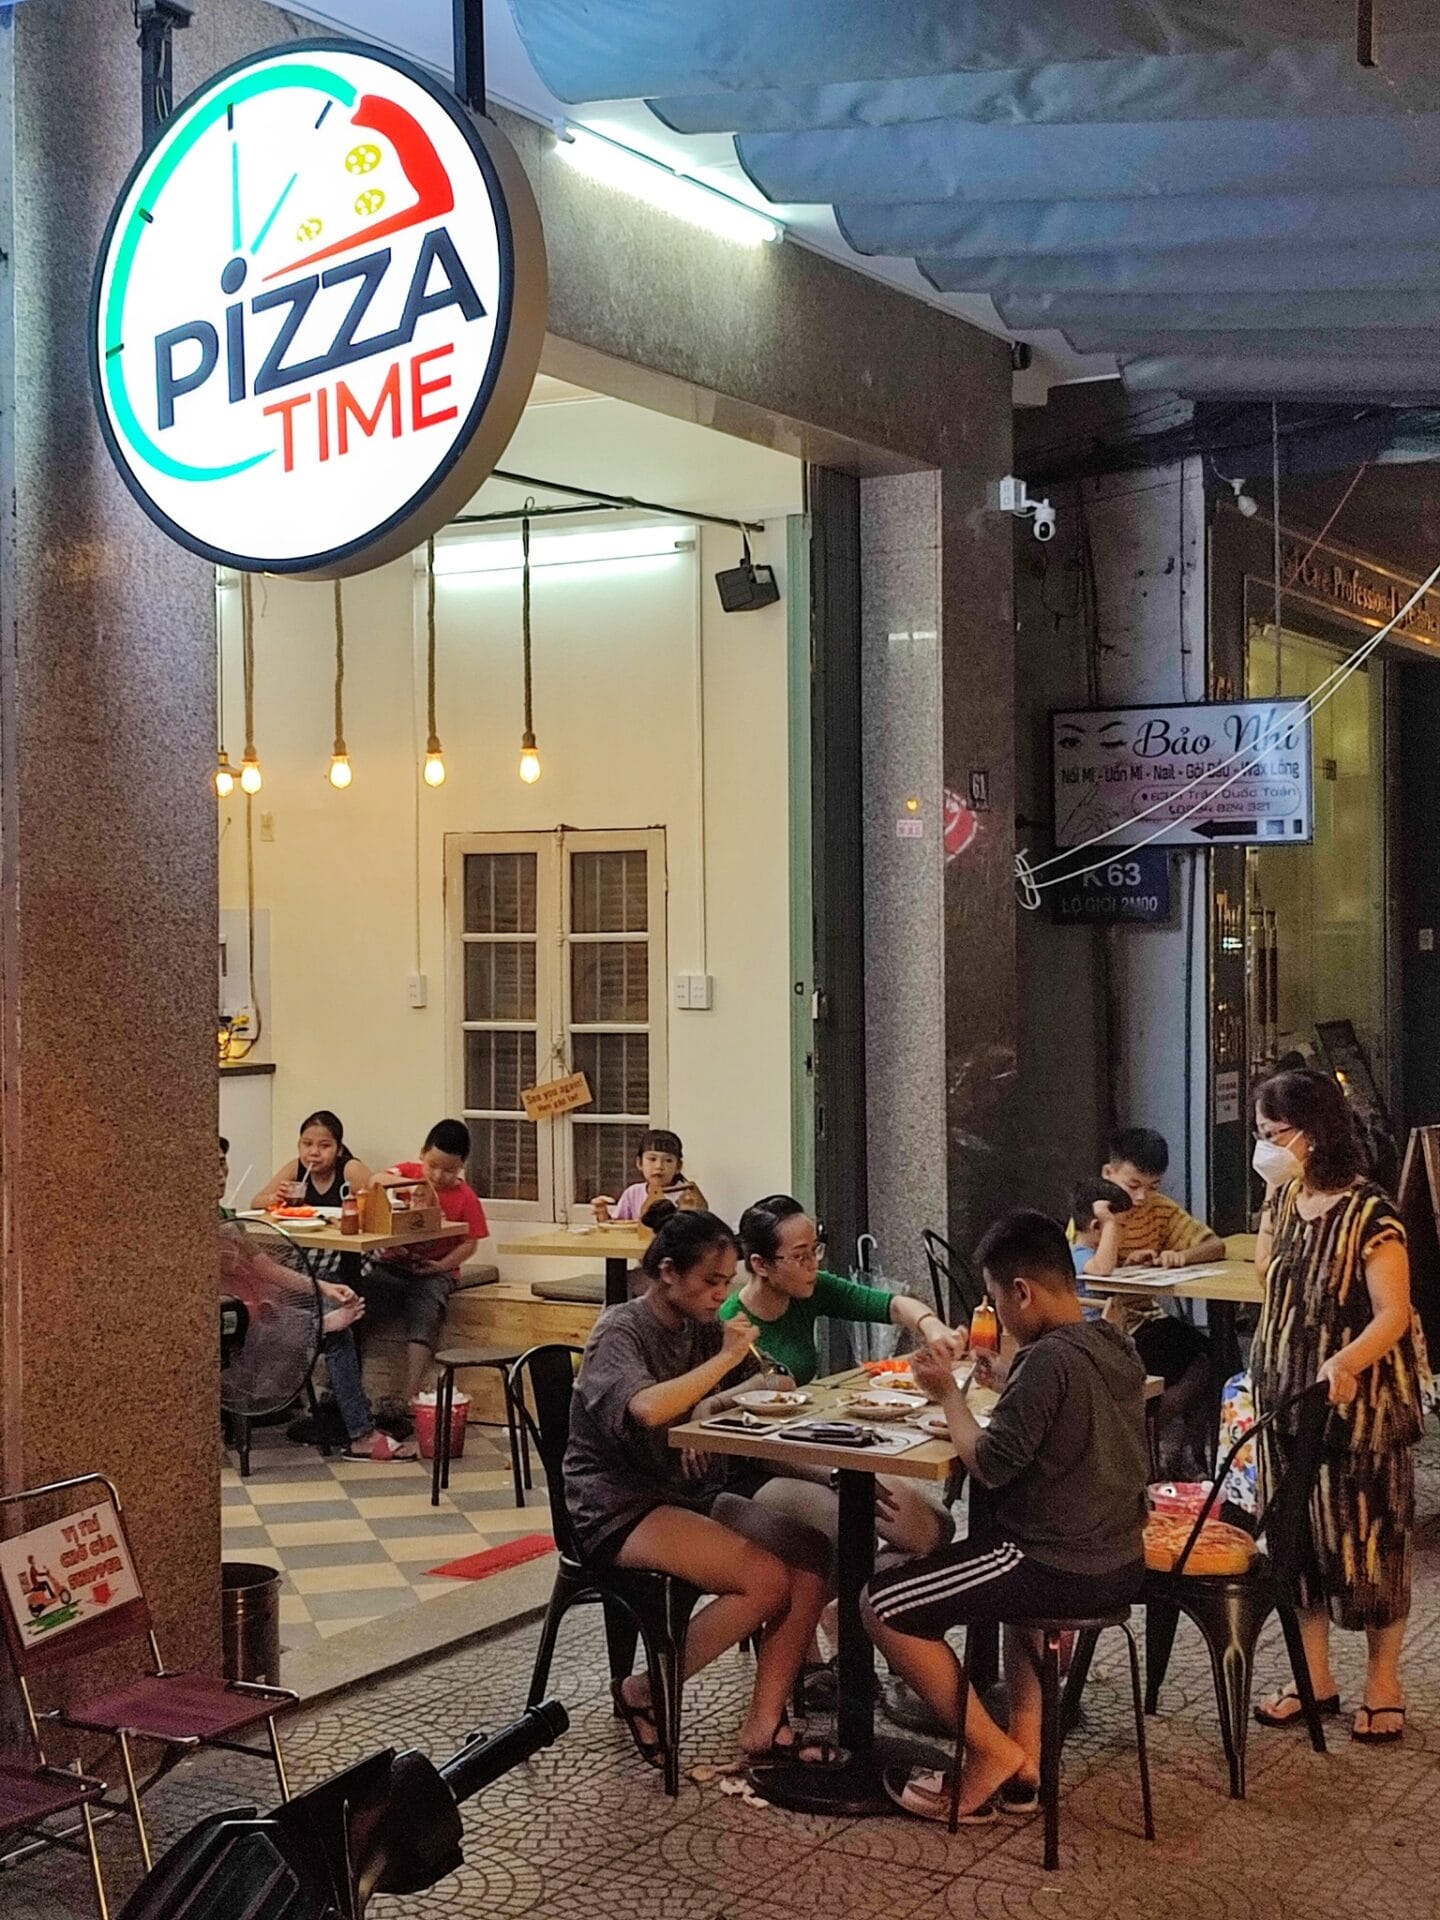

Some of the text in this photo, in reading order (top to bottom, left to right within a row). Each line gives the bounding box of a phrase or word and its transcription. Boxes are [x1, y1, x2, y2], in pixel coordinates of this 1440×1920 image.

[262, 342, 458, 473] TIME
[1131, 718, 1216, 759] Bảo
[972, 773, 986, 799] 61
[1153, 763, 1175, 780] Nail
[1107, 862, 1142, 887] 63
[67, 1556, 124, 1590] SHIPPER
